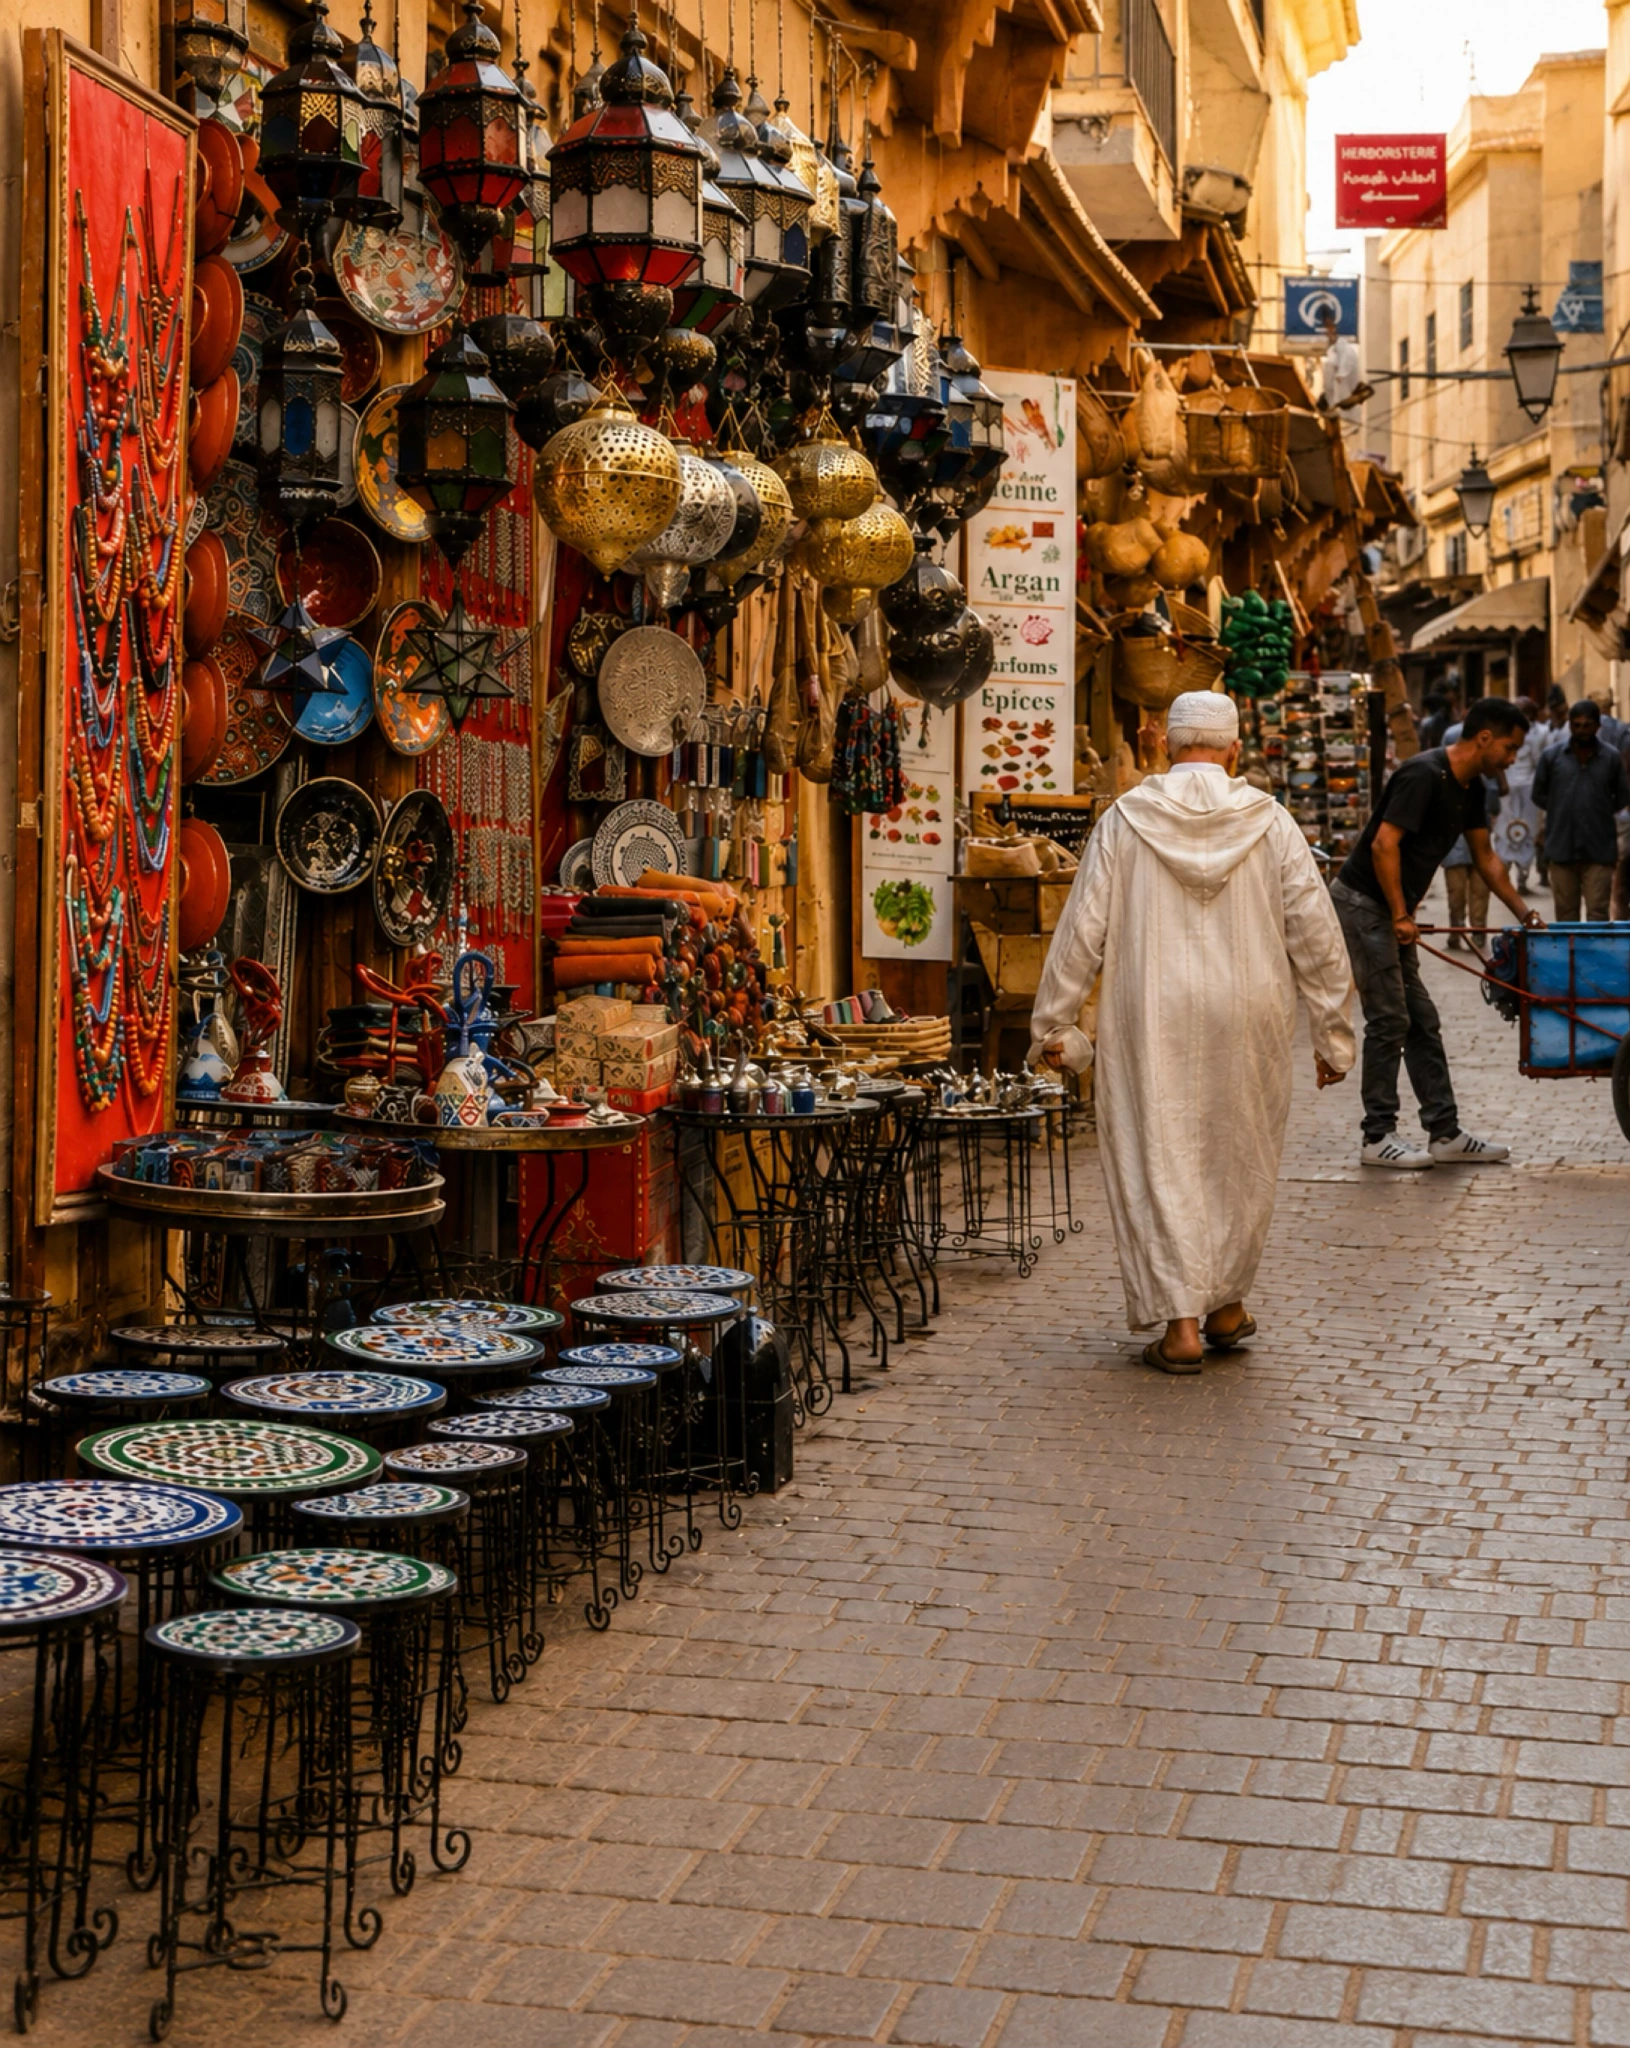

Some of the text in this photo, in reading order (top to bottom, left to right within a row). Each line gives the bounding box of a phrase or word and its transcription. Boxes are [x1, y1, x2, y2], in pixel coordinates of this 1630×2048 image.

[992, 482, 1057, 502] enne
[981, 566, 1060, 595] Argan
[992, 656, 1058, 675] arfoms
